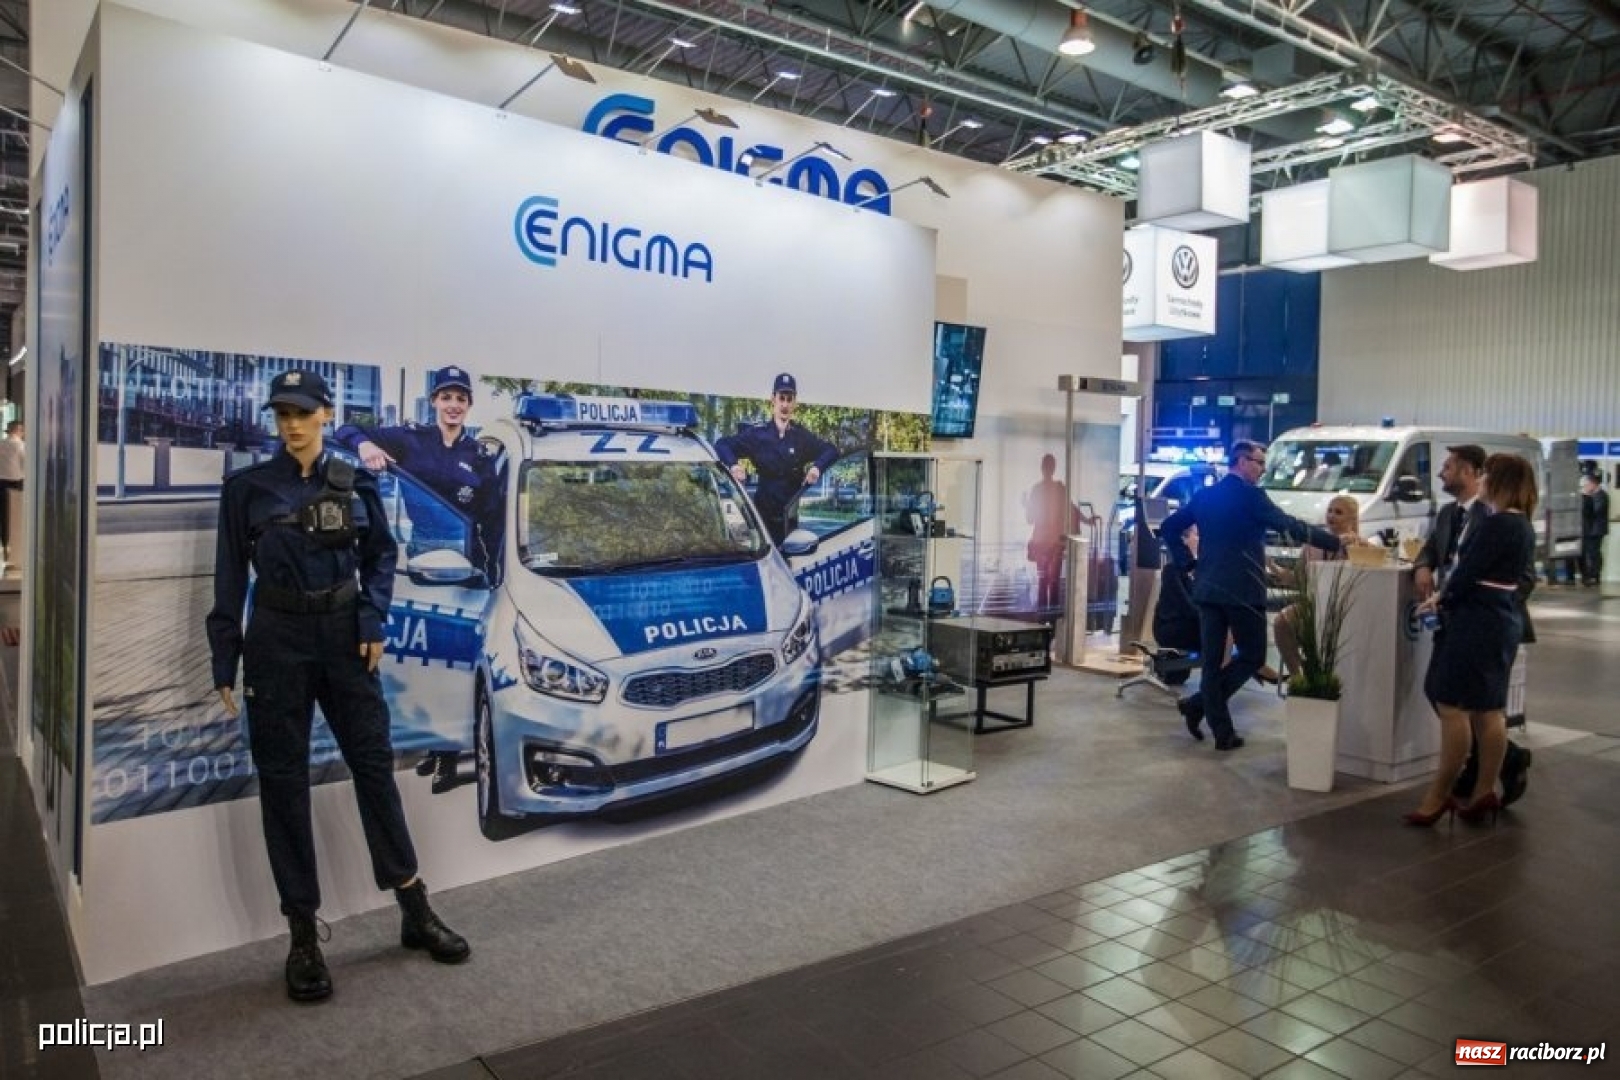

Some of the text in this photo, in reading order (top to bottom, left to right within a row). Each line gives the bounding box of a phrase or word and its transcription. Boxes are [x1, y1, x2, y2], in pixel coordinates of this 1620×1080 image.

[580, 402, 638, 422] POLICJA
[805, 557, 860, 595] POLICJA
[644, 614, 748, 644] POLICJA
